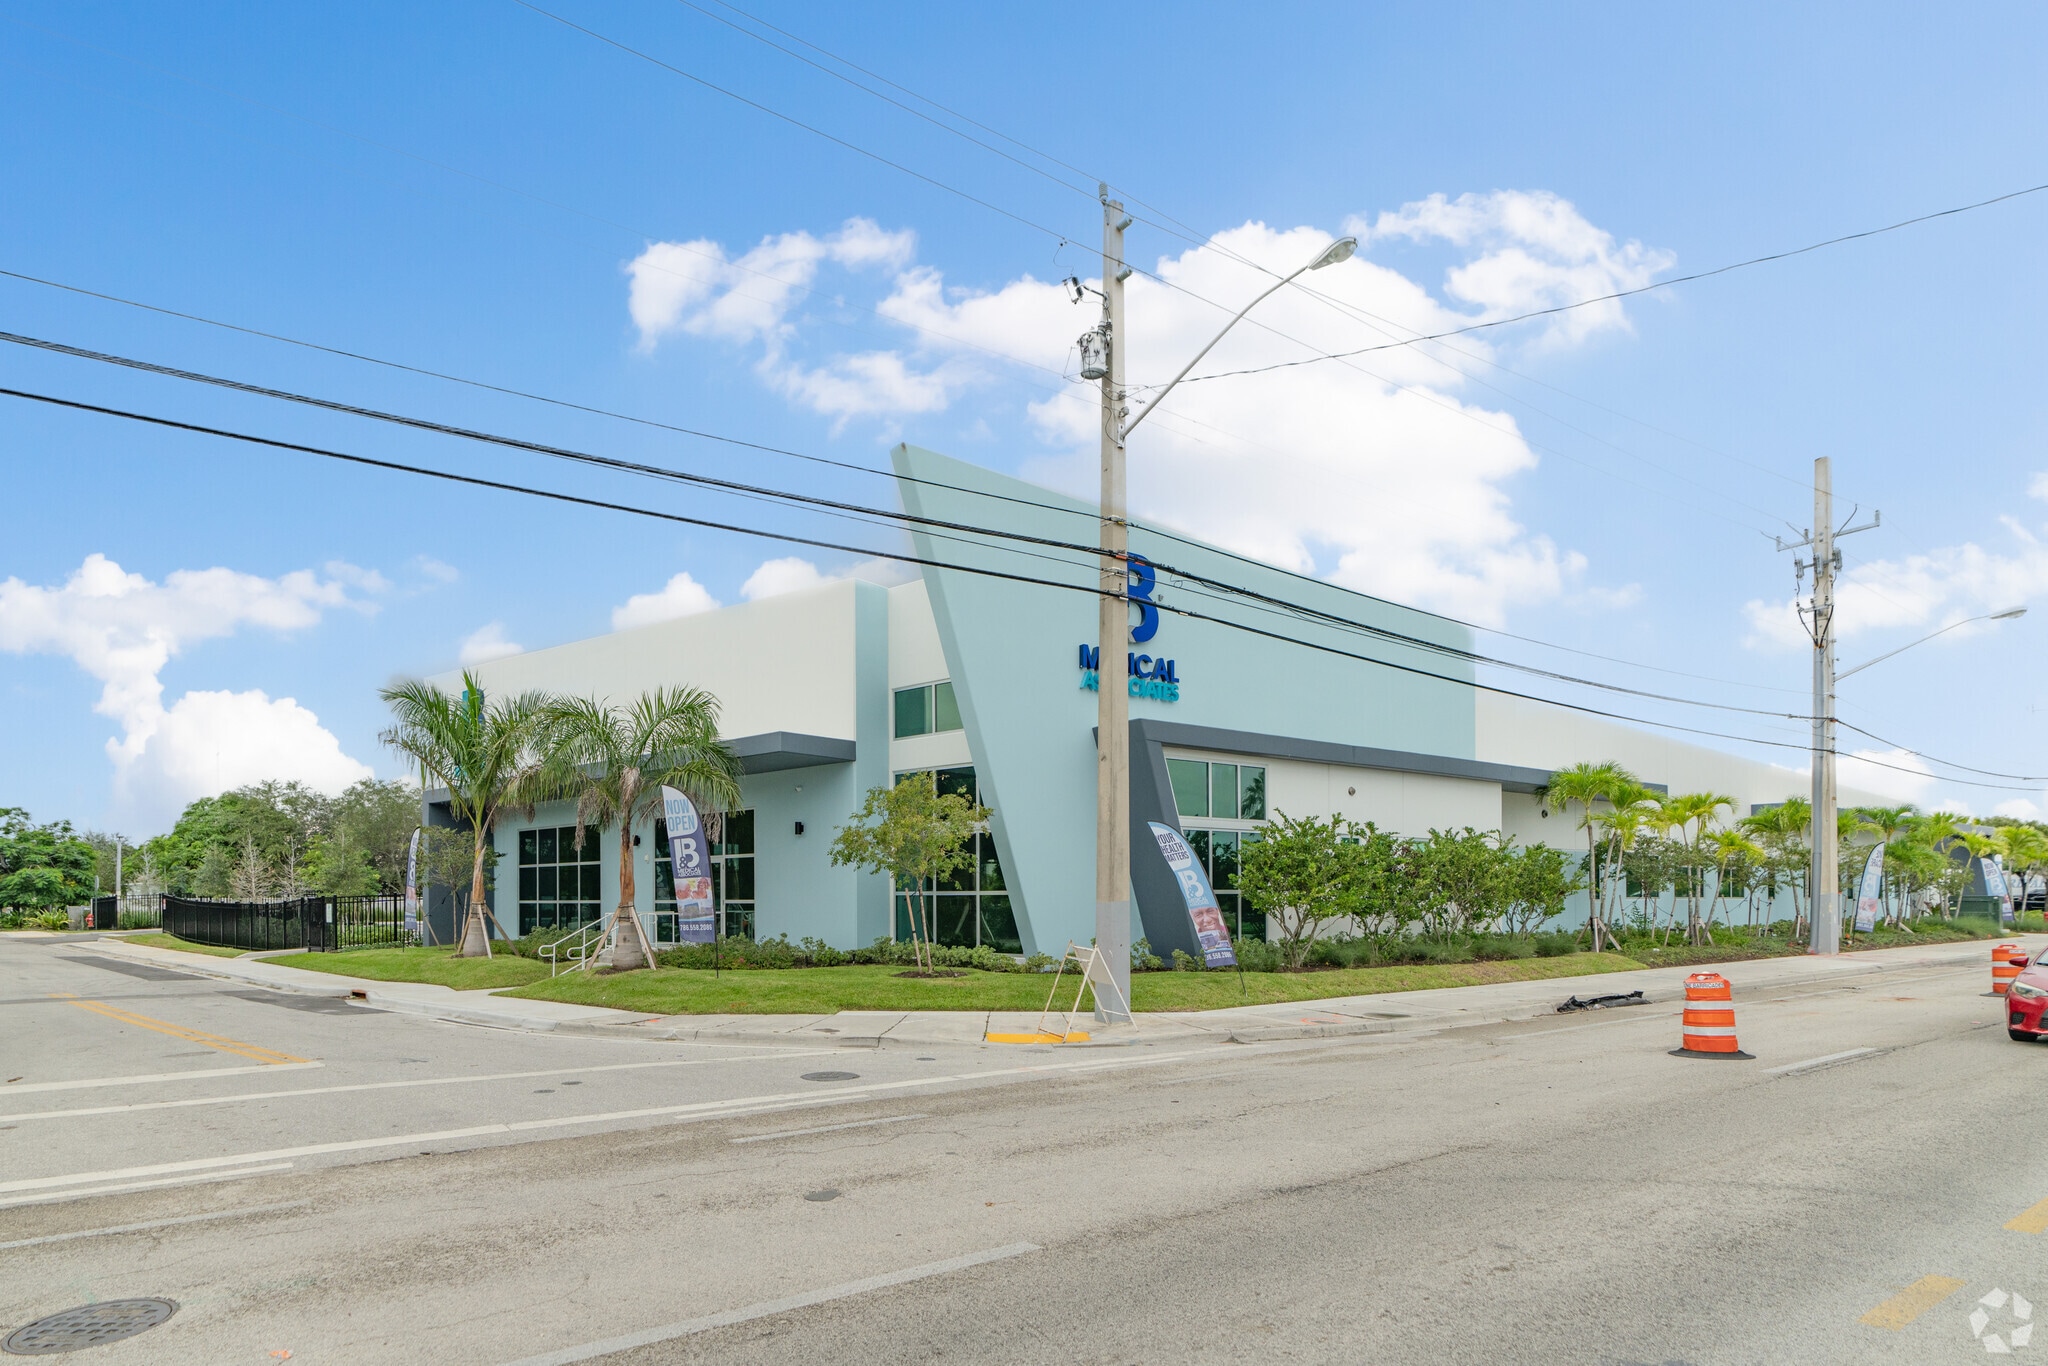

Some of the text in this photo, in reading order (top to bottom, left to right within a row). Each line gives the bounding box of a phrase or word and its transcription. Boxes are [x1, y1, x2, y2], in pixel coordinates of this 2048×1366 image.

[1079, 644, 1179, 683] MICAL
[1080, 670, 1180, 702] ASCIATES
[665, 799, 690, 815] NOW
[667, 814, 696, 832] OPEN
[1157, 832, 1176, 845] YOUR
[1160, 842, 1185, 855] HEALTH
